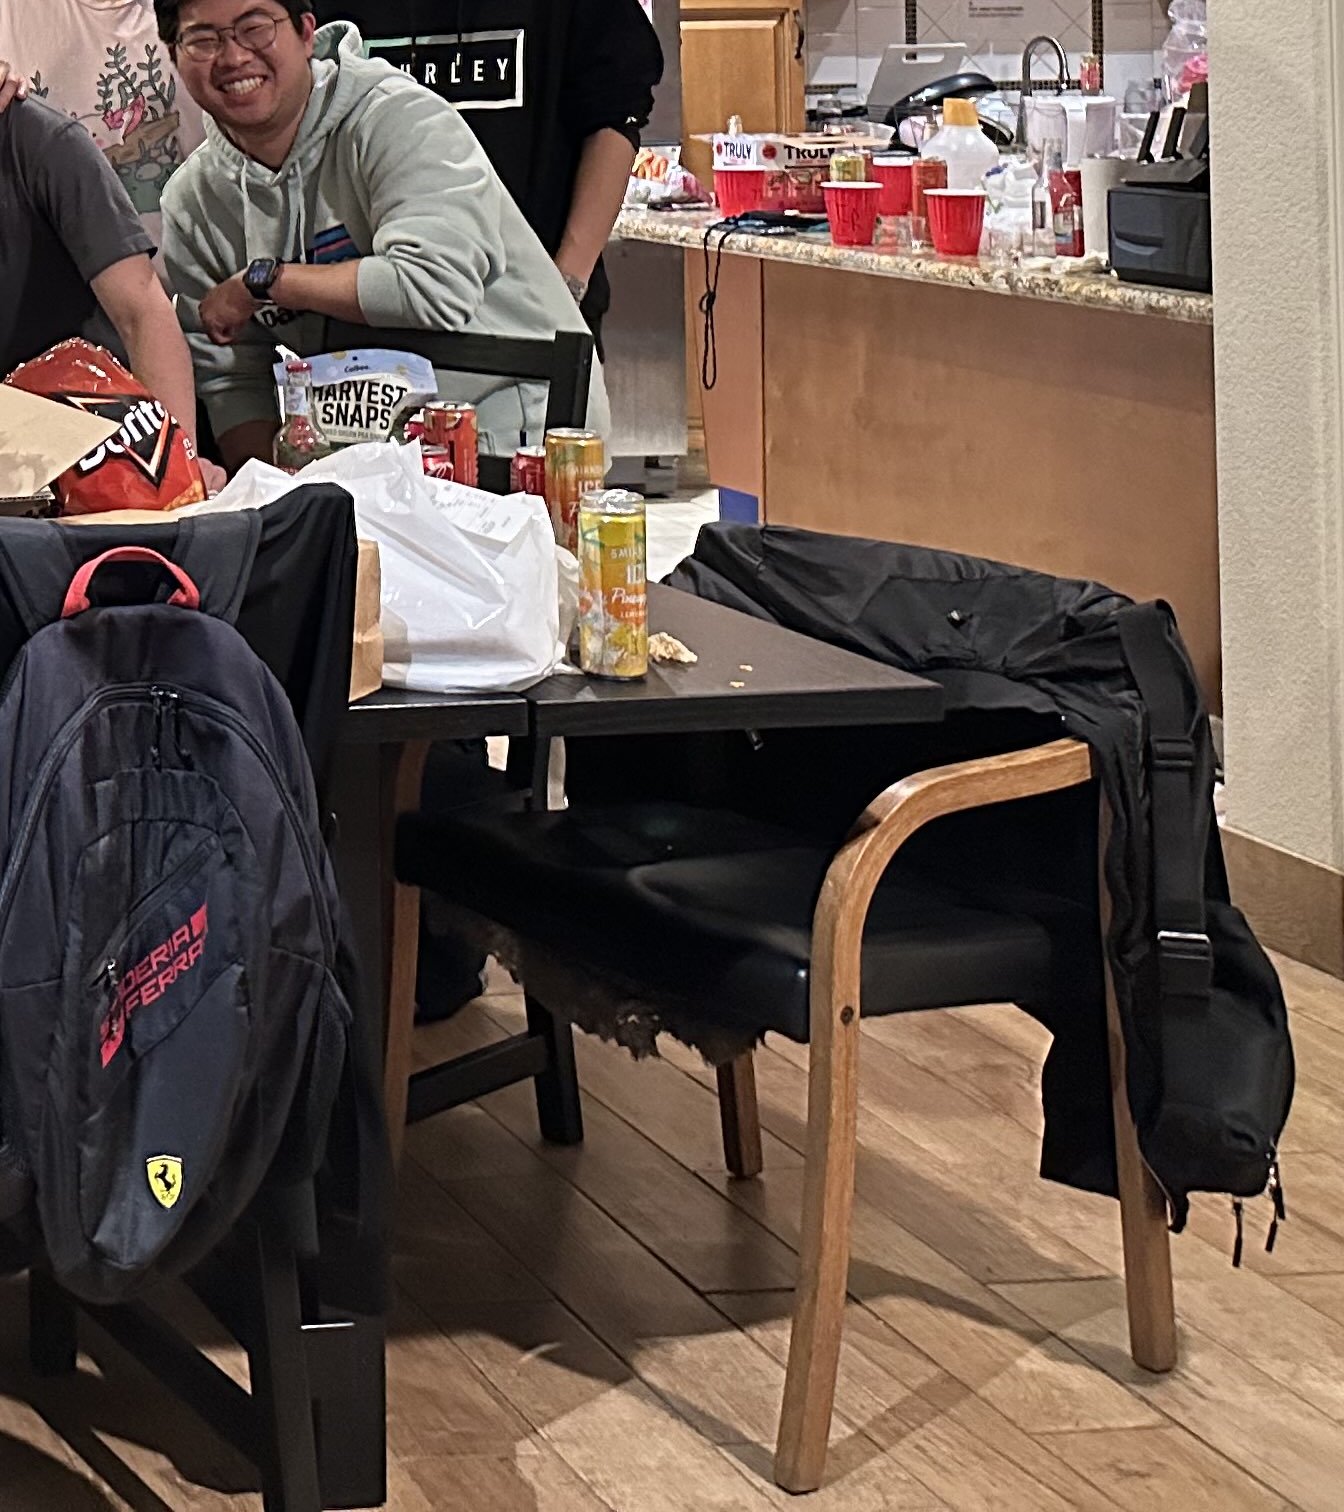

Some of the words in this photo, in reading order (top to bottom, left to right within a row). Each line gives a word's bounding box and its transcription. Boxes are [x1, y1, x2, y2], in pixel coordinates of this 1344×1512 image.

[400, 53, 509, 85] RLEY
[723, 141, 752, 160] TRULY
[783, 145, 835, 160] TRULY
[313, 379, 408, 409] HARVEST
[322, 402, 391, 430] SNAPS
[78, 400, 166, 472] orit
[118, 924, 190, 996] DERIA
[124, 938, 204, 1014] FERRA
